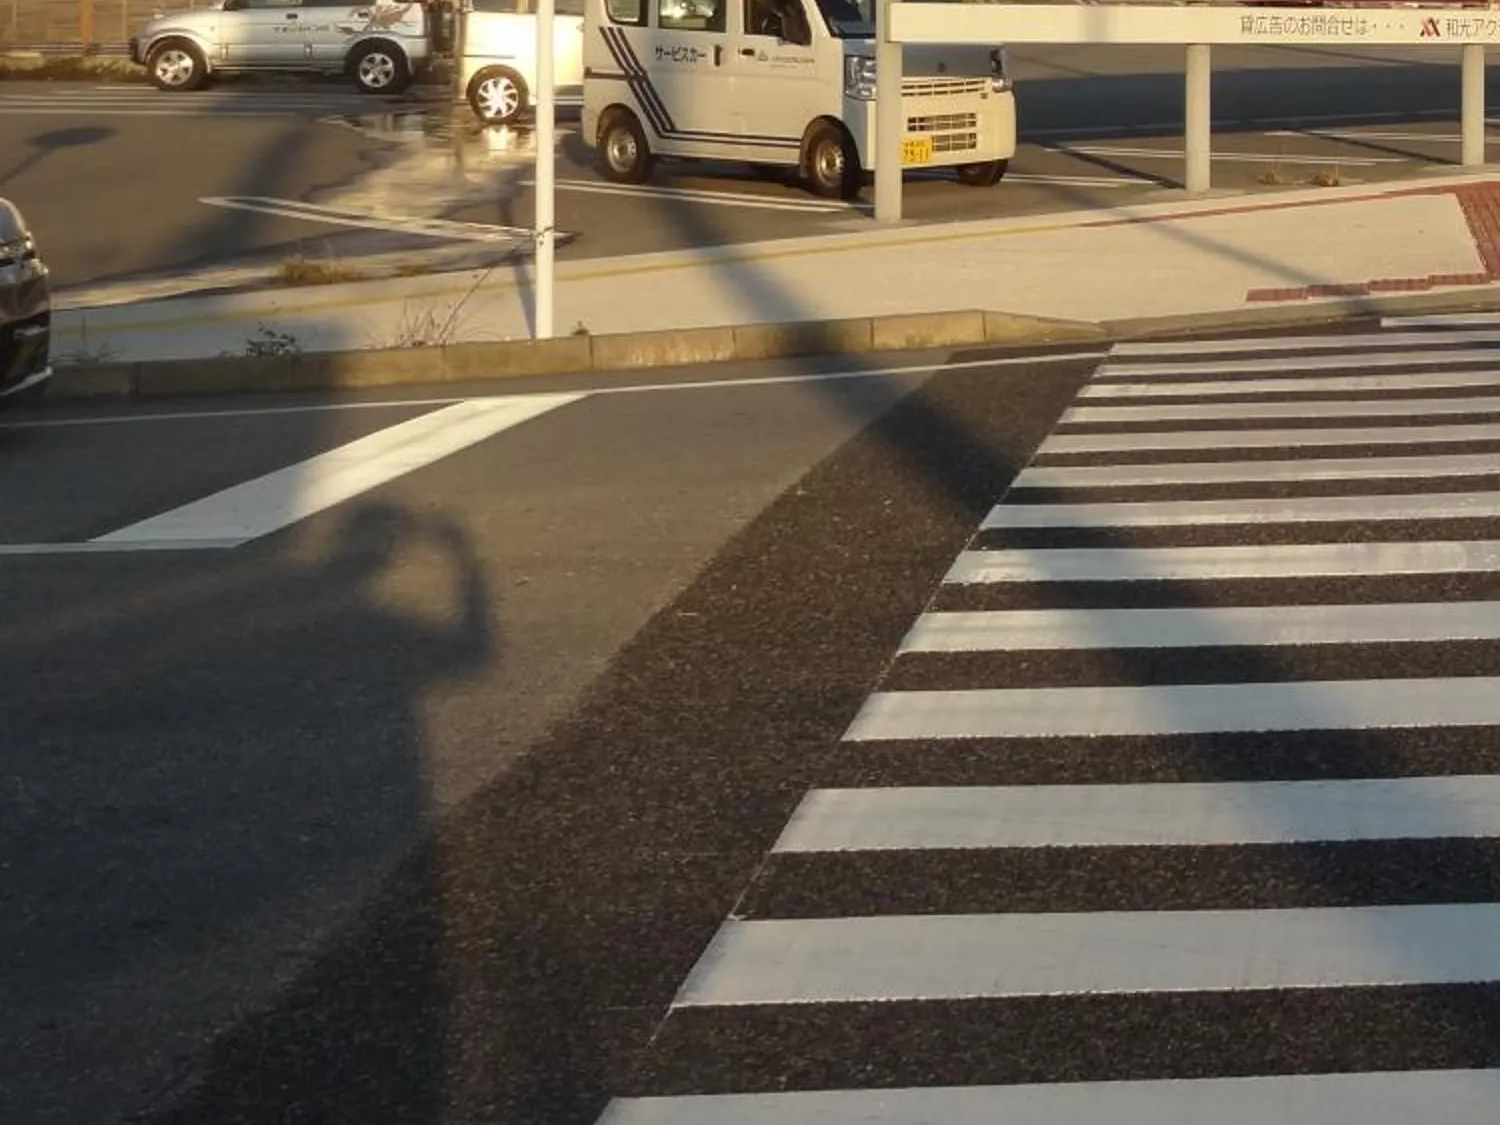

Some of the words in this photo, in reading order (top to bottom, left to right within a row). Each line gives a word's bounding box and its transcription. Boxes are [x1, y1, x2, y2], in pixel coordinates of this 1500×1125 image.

[655, 45, 707, 63] サービスカー
